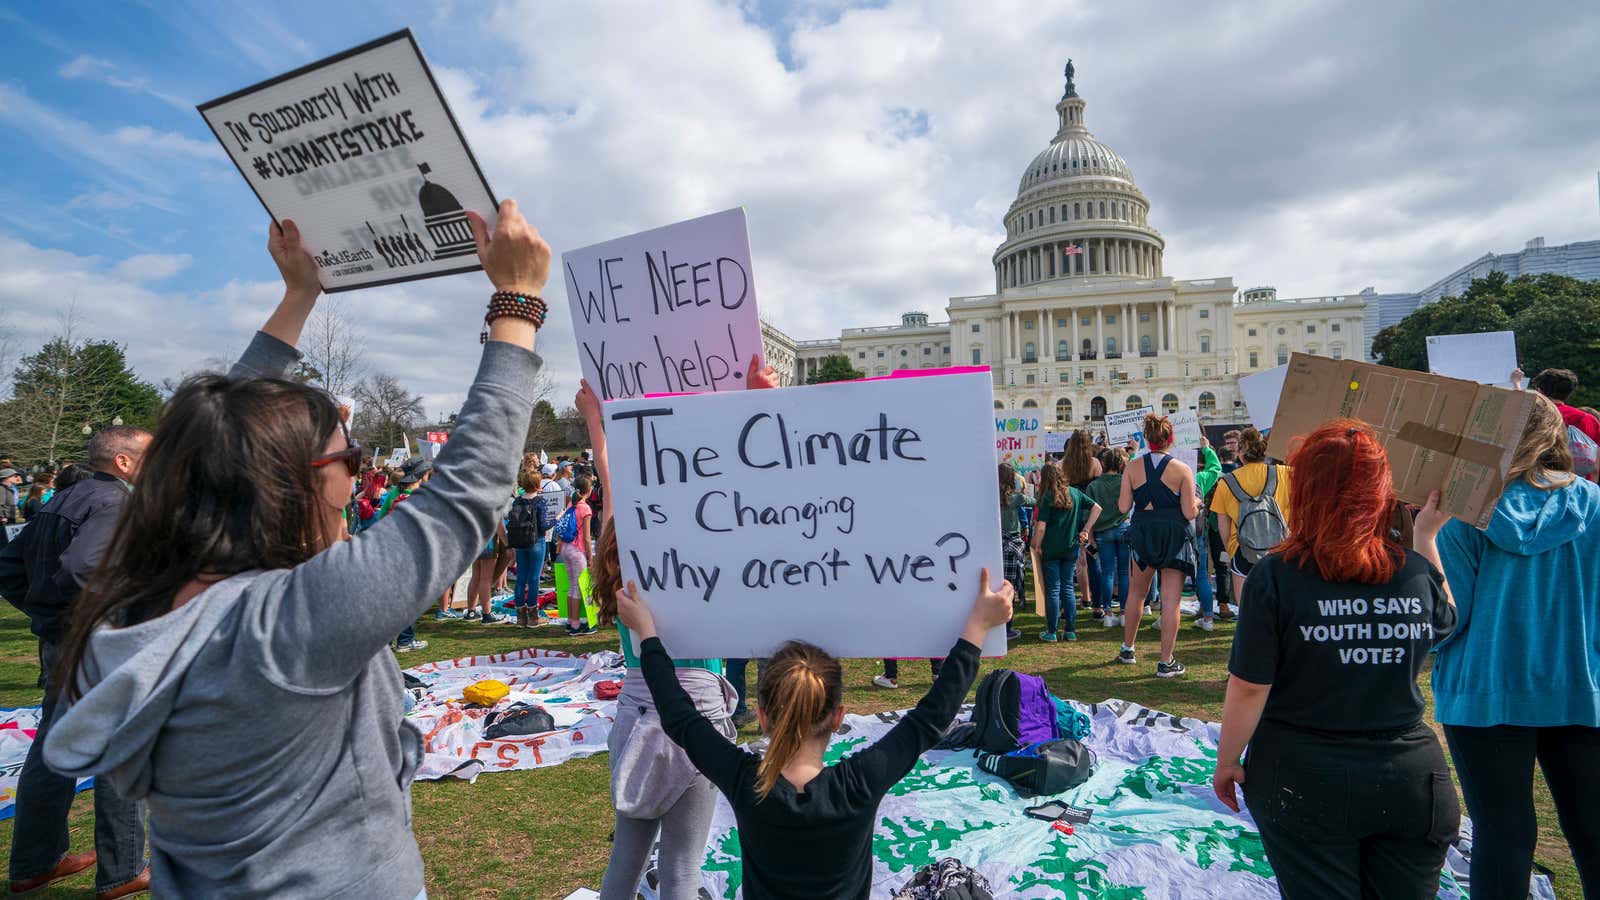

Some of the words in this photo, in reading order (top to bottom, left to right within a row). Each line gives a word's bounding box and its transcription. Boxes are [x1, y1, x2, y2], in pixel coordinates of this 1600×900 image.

[248, 86, 347, 144] SOLIDARITY
[343, 72, 400, 115] WITH
[253, 109, 424, 180] #CLIMATESTRIKE
[342, 247, 374, 263] Earth
[567, 257, 631, 325] WE
[645, 250, 748, 315] NEED
[583, 341, 648, 400] Your
[654, 323, 743, 392] help!
[611, 407, 723, 486] The
[737, 411, 927, 469] Climate
[995, 417, 1039, 432] WORLD
[996, 436, 1022, 451] ORTH
[1026, 435, 1037, 449] IT
[634, 500, 668, 531] is
[695, 490, 855, 539] Changing
[629, 548, 721, 603] Why
[742, 548, 850, 589] aren't
[865, 532, 971, 591] we?
[1317, 598, 1369, 617] WHO
[1372, 597, 1422, 615] SAYS
[1299, 623, 1372, 642] YOUTH
[1338, 647, 1406, 665] VOTE?
